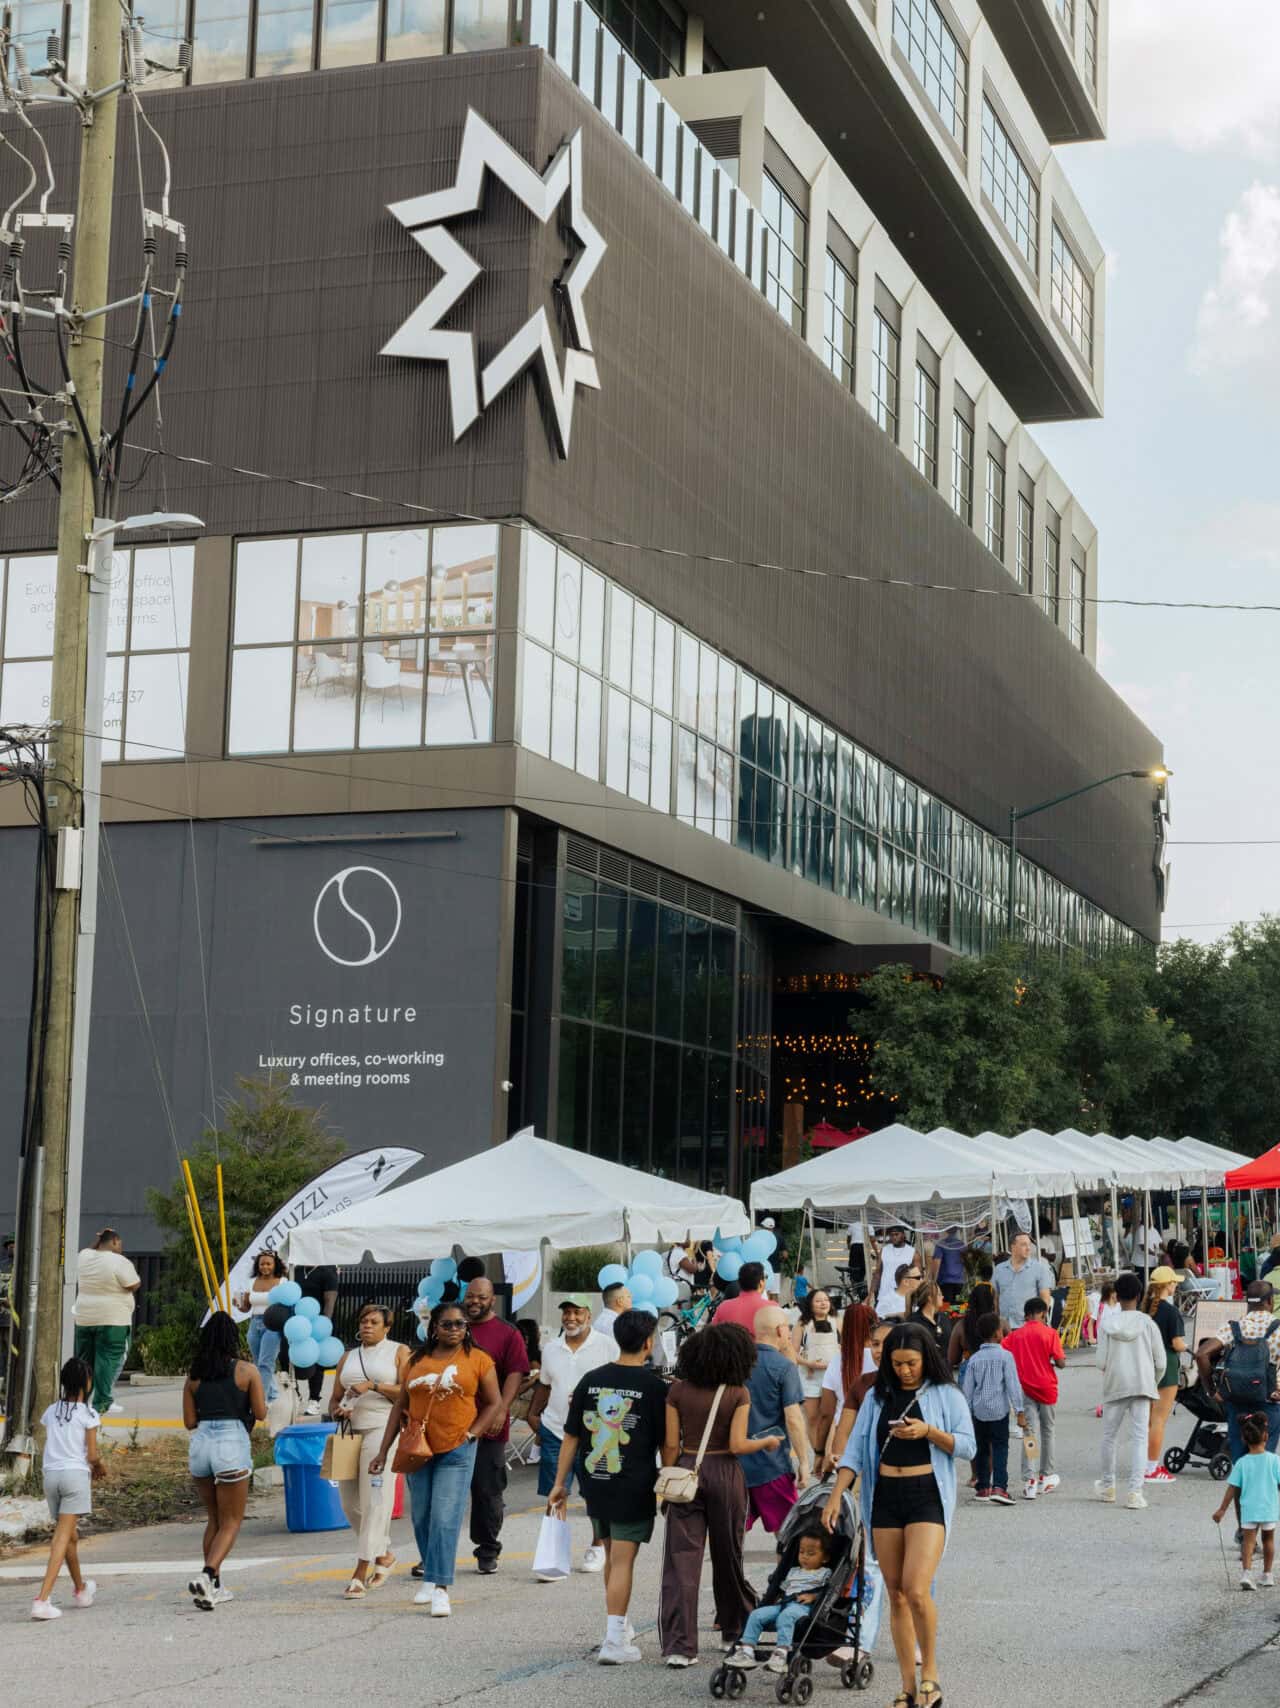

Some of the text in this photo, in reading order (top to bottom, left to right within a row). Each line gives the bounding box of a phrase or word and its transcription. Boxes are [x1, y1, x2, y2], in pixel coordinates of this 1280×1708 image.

[289, 1004, 417, 1028] Signature
[258, 1051, 445, 1069] Luxury offices, co-working
[290, 1071, 411, 1088] & meeting rooms
[252, 1186, 329, 1260] ATUZZI
